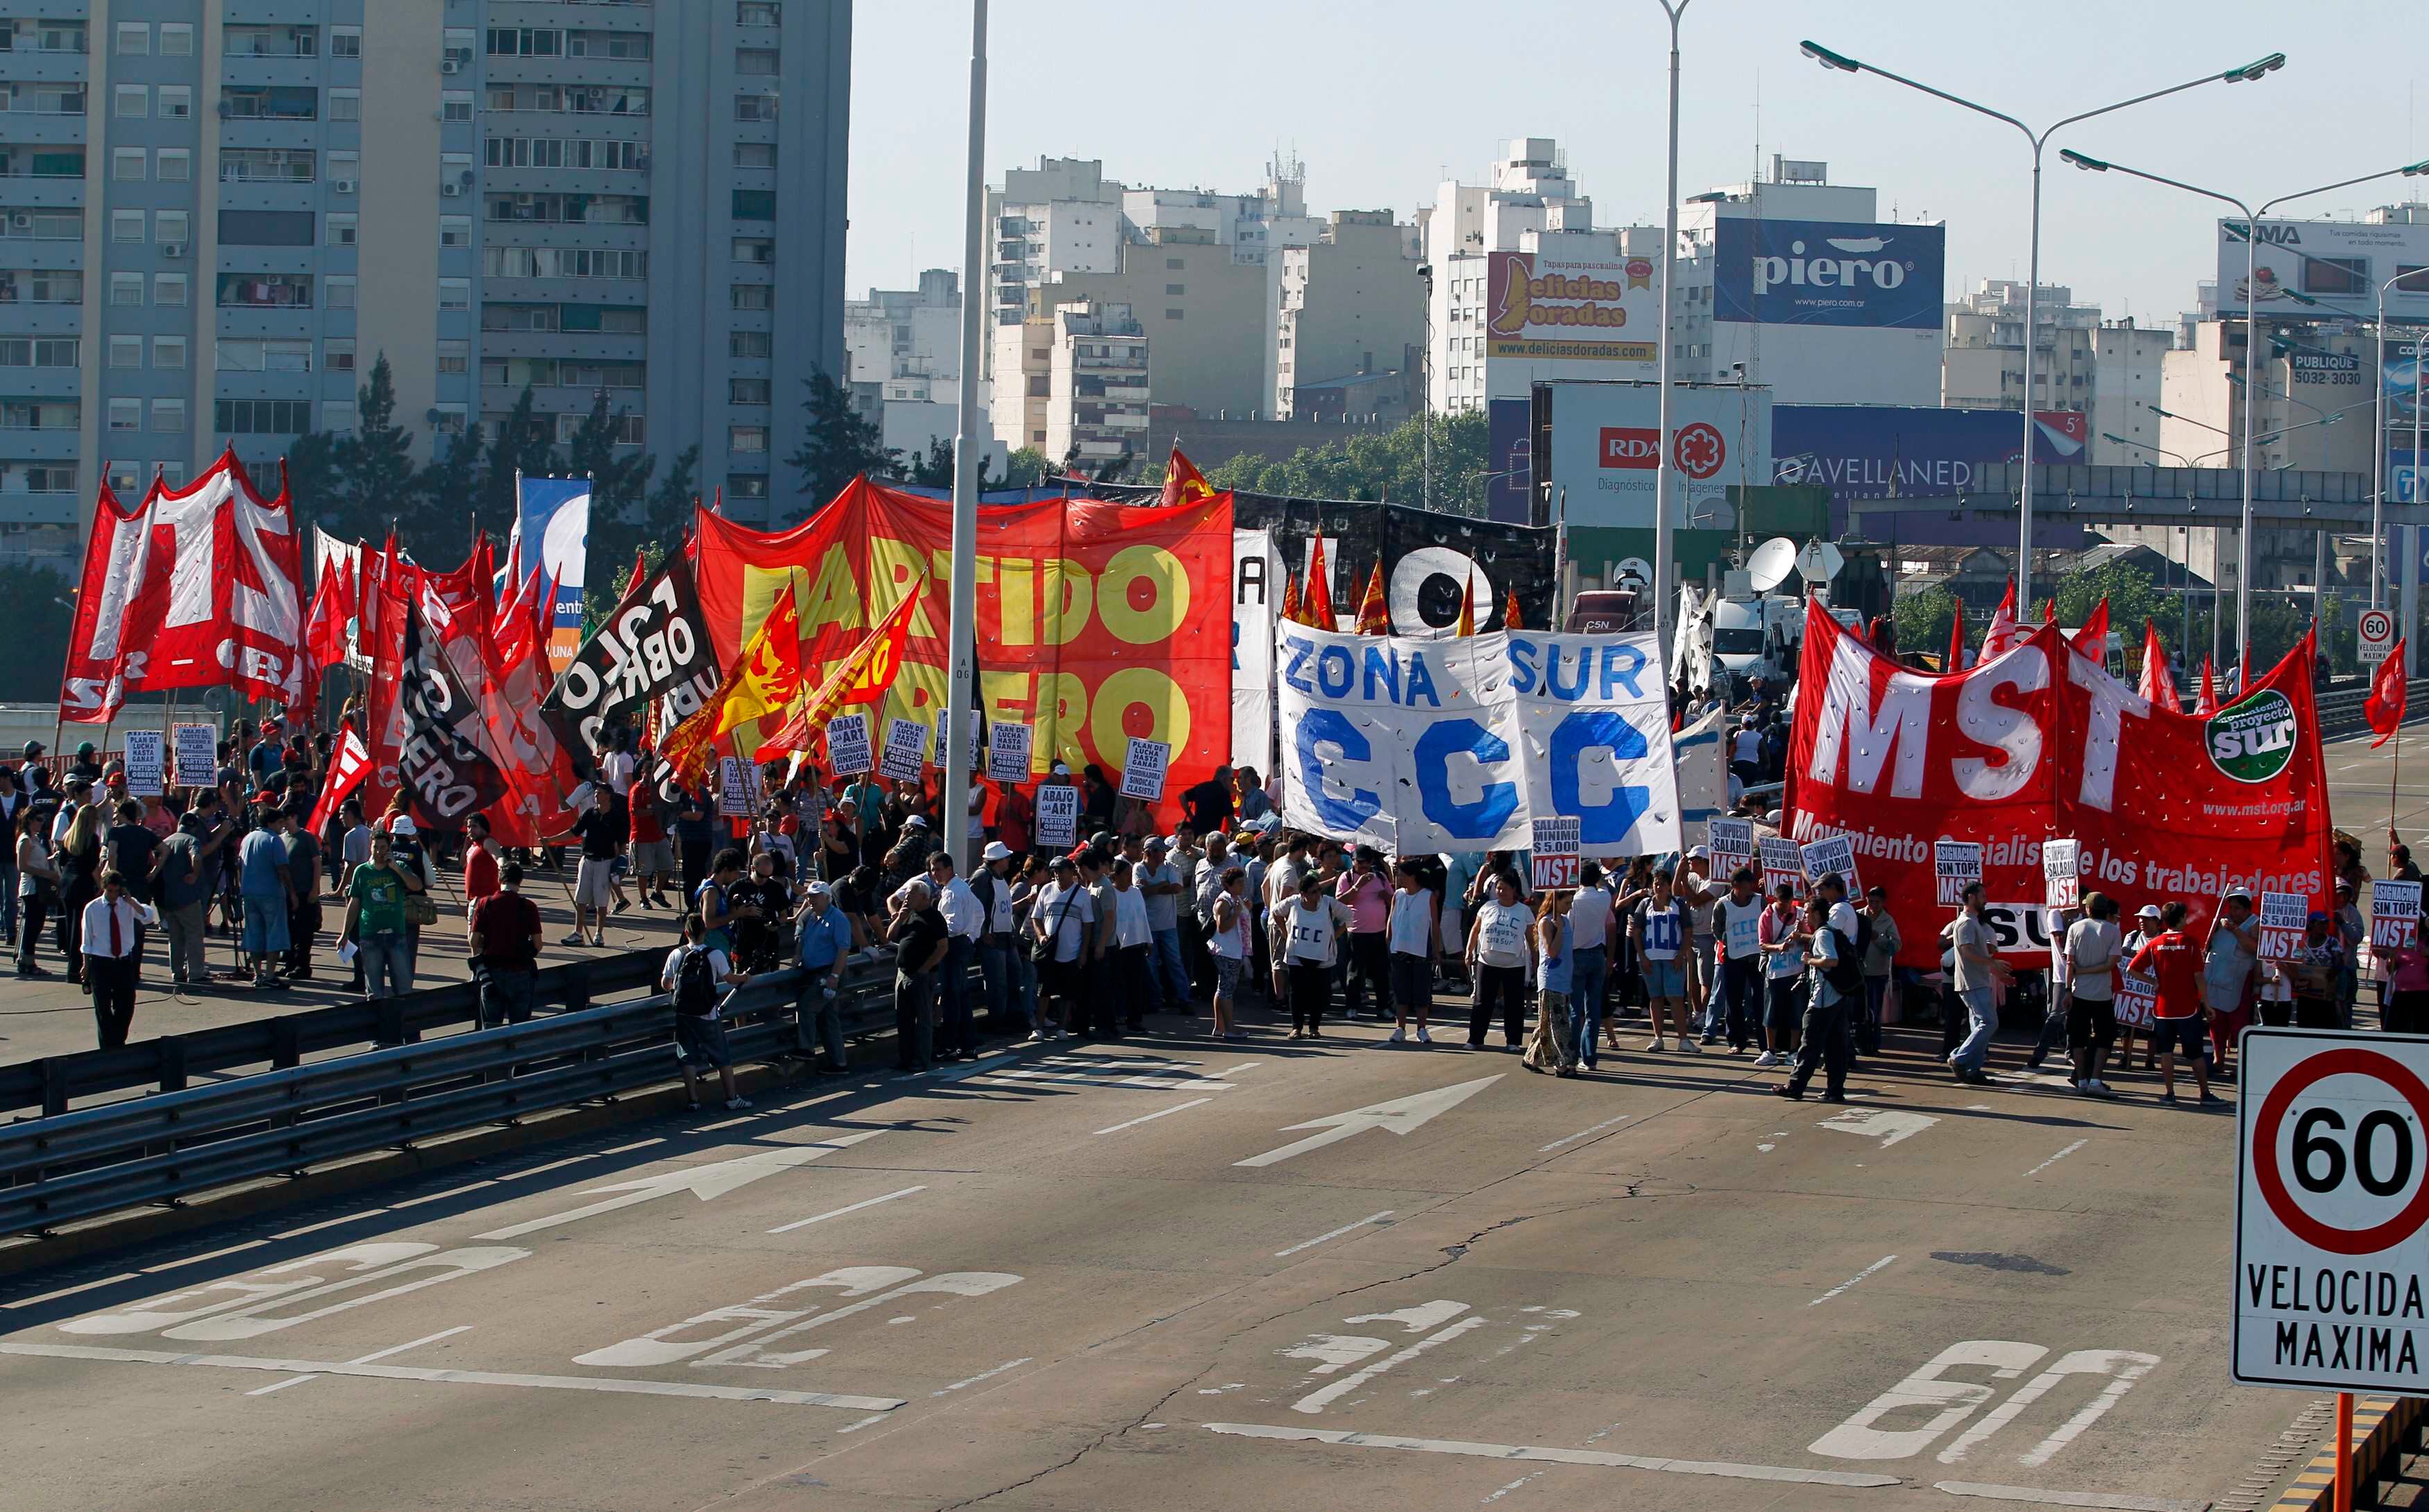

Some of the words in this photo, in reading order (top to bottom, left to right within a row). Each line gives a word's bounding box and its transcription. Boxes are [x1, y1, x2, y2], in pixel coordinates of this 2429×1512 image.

[1543, 260, 1565, 269] Tapas
[1566, 262, 1582, 270] para
[1752, 241, 1904, 295] piero
[1795, 298, 1865, 308] www.piero.com.ar
[1498, 342, 1646, 357] www.deliciasdoradas.com
[2296, 355, 2353, 369] PUBLIQUE
[1806, 458, 1976, 486] AVELLANED
[1598, 477, 1655, 493] Diagnóstico
[1586, 620, 1609, 629] C5N
[2367, 620, 2385, 634] 60
[553, 646, 573, 658] UNA
[1285, 635, 1441, 707] ZONA
[1506, 638, 1646, 701] SUR
[831, 717, 863, 733] ABAJO
[896, 720, 915, 731] PLAN
[1809, 632, 2150, 813] MST
[2231, 708, 2290, 733] proyecto
[843, 729, 864, 743] ART
[896, 733, 918, 743] HASTA
[897, 727, 919, 738] LUCHA
[2214, 719, 2294, 759] sur
[894, 740, 917, 749] GANAR
[1135, 747, 1159, 756] LUCHA
[836, 752, 869, 765] SINDICAL
[886, 747, 922, 760] PARTIDO
[1134, 754, 1158, 763] HASTA
[838, 761, 870, 772] CLASISTA
[889, 755, 922, 767] OBRERO
[1133, 760, 1158, 769] GANAR
[880, 768, 919, 782] IZQUIERDA
[886, 763, 912, 774] FRENTE
[1129, 776, 1155, 788] SINDICAL
[1296, 708, 1650, 844] CCC
[1042, 790, 1074, 802] ABAJO
[1127, 785, 1154, 796] CLASISTA
[1052, 803, 1073, 815] ART
[2203, 799, 2305, 816] www.mst.org.ar
[1533, 819, 1580, 831] SALARIO
[1720, 824, 1750, 840] IMPUESTO
[1534, 831, 1580, 841] MINIMO
[1534, 842, 1541, 853] $
[1544, 841, 1580, 852] 5.000
[1714, 838, 1750, 855] SALARIO
[1759, 837, 1797, 850] SALARIO
[1761, 849, 1799, 860] MINIMO
[1815, 842, 1848, 860] IMPUESTO
[1936, 844, 1979, 861] ASIGNACIÓN
[1763, 858, 1768, 868] $
[1771, 859, 1800, 870] 5.000
[1812, 854, 1853, 878] SALARIO
[1937, 862, 1953, 875] SIN
[1954, 863, 1979, 875] TOPE
[2049, 860, 2075, 878] SALARIO
[1535, 858, 1577, 886] MST
[2099, 848, 2137, 885] los
[2145, 859, 2321, 901] trabajadores
[2048, 878, 2076, 906] MST
[2374, 885, 2421, 902] ASIGNACIÓN
[2263, 894, 2306, 906] SALARIO
[2263, 904, 2306, 917] MINIMO
[2373, 901, 2392, 915] SIN
[2394, 903, 2418, 915] TOPE
[2261, 915, 2267, 926] $
[2271, 916, 2305, 928] 5.000
[1293, 926, 1323, 943] CCC
[2373, 919, 2414, 948] MST
[2260, 931, 2302, 958] MST
[2114, 994, 2154, 1025] MST
[2292, 1107, 2413, 1197] 60
[2248, 1263, 2425, 1318] VELOCIDA
[2275, 1321, 2419, 1375] MAXIMA
